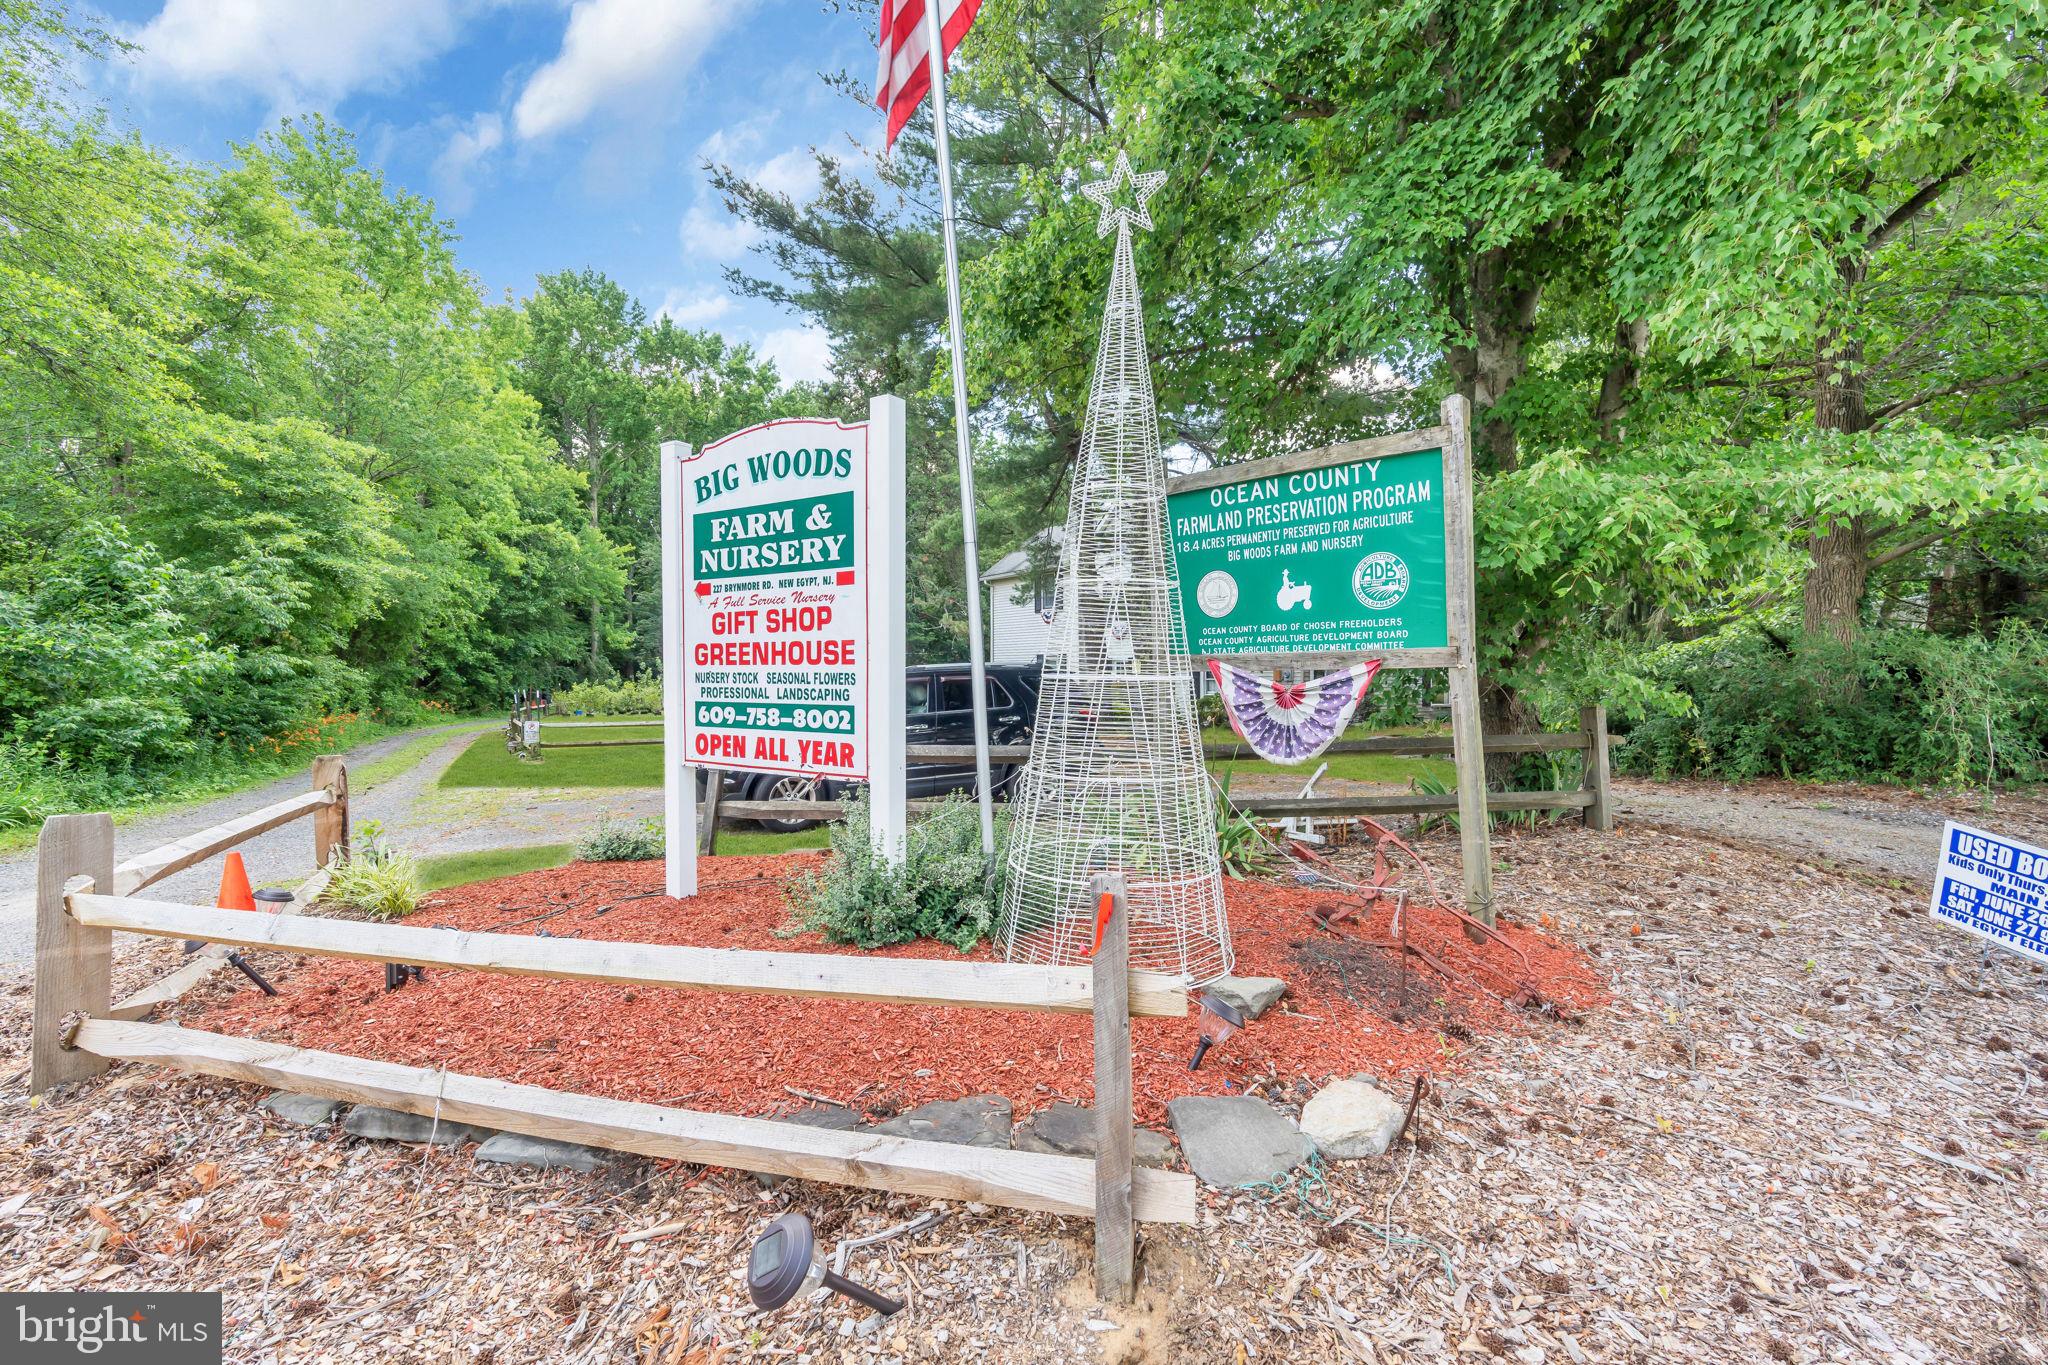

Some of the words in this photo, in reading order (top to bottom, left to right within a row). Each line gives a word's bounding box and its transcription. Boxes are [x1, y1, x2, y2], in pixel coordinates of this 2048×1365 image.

[693, 463, 739, 504] BIG
[747, 448, 852, 484] WOODS
[1210, 478, 1279, 508] OCEAN
[1288, 459, 1381, 495] COUNTY
[1177, 509, 1242, 537] FARMLAND
[1246, 493, 1348, 527] PRESERVATION
[1353, 479, 1431, 512] PROGRAM
[710, 508, 794, 542] FARM
[805, 503, 832, 531] &
[1177, 540, 1199, 553] 18.4
[1201, 537, 1225, 550] ACRES
[1227, 529, 1281, 546] PERMANENTLY
[1283, 522, 1330, 540] PRESERVED
[1333, 520, 1350, 532] FOR
[1352, 510, 1414, 531] AGRICULTURE
[700, 534, 846, 573] NURSERY
[1228, 551, 1240, 562] BIG
[1243, 546, 1272, 560] WOODS
[1274, 543, 1298, 557] FARM
[1301, 541, 1319, 553] AND
[1321, 534, 1364, 551] NURSERY
[1361, 560, 1397, 580] ADB
[713, 584, 723, 593] 227
[724, 581, 760, 593] BRYNMORE
[762, 580, 774, 590] RD.
[779, 578, 794, 588] NEW
[796, 577, 820, 587] EGYPT,
[823, 576, 834, 585] NJ.
[708, 597, 719, 609] A
[723, 595, 746, 609] Full
[749, 593, 786, 606] Service
[791, 591, 836, 604] Nursery
[711, 610, 758, 635] GIFT
[766, 606, 832, 633] SHOP
[1202, 627, 1227, 635] OCEAN
[1229, 625, 1258, 634] COUNTY
[1261, 623, 1288, 632] BOARD
[1290, 622, 1301, 631] OF
[1303, 621, 1337, 630] CHOSEN
[1339, 617, 1402, 628] FREEHOLDERS
[1198, 638, 1222, 646] OCEAN
[1224, 636, 1254, 645] COUNTY
[1256, 633, 1310, 643] AGRICULTURE
[1312, 631, 1373, 642] DEVELOPMENT
[1377, 630, 1408, 639] BOARD
[1239, 645, 1290, 654] AGRICULTURE
[1292, 643, 1352, 653] DEVELOPMENT
[1355, 641, 1405, 651] COMMITTEE
[694, 640, 856, 666] GREENHOUSE
[695, 672, 730, 684] NURSERY
[732, 672, 759, 684] STOCK
[766, 672, 811, 685] SEASONAL
[813, 672, 856, 686] FLOWERS
[700, 687, 770, 700] PROFESSIONAL
[776, 687, 850, 701] LANDSCAPING
[698, 705, 852, 730] 609-758-8002
[695, 733, 746, 759] OPEN
[754, 736, 789, 762] ALL
[798, 739, 855, 769] YEAR
[1957, 833, 2014, 869] USED
[1948, 854, 1975, 872] Kids
[1977, 864, 2006, 882] Only
[2008, 873, 2047, 898] Thurs,
[1982, 893, 2025, 919] JUNE
[1990, 882, 2039, 907] MAIN
[1938, 906, 1969, 924] NEW
[1972, 918, 2017, 942] EGYPT
[1977, 907, 2013, 930] JUNE
[2015, 919, 2040, 939] 27
